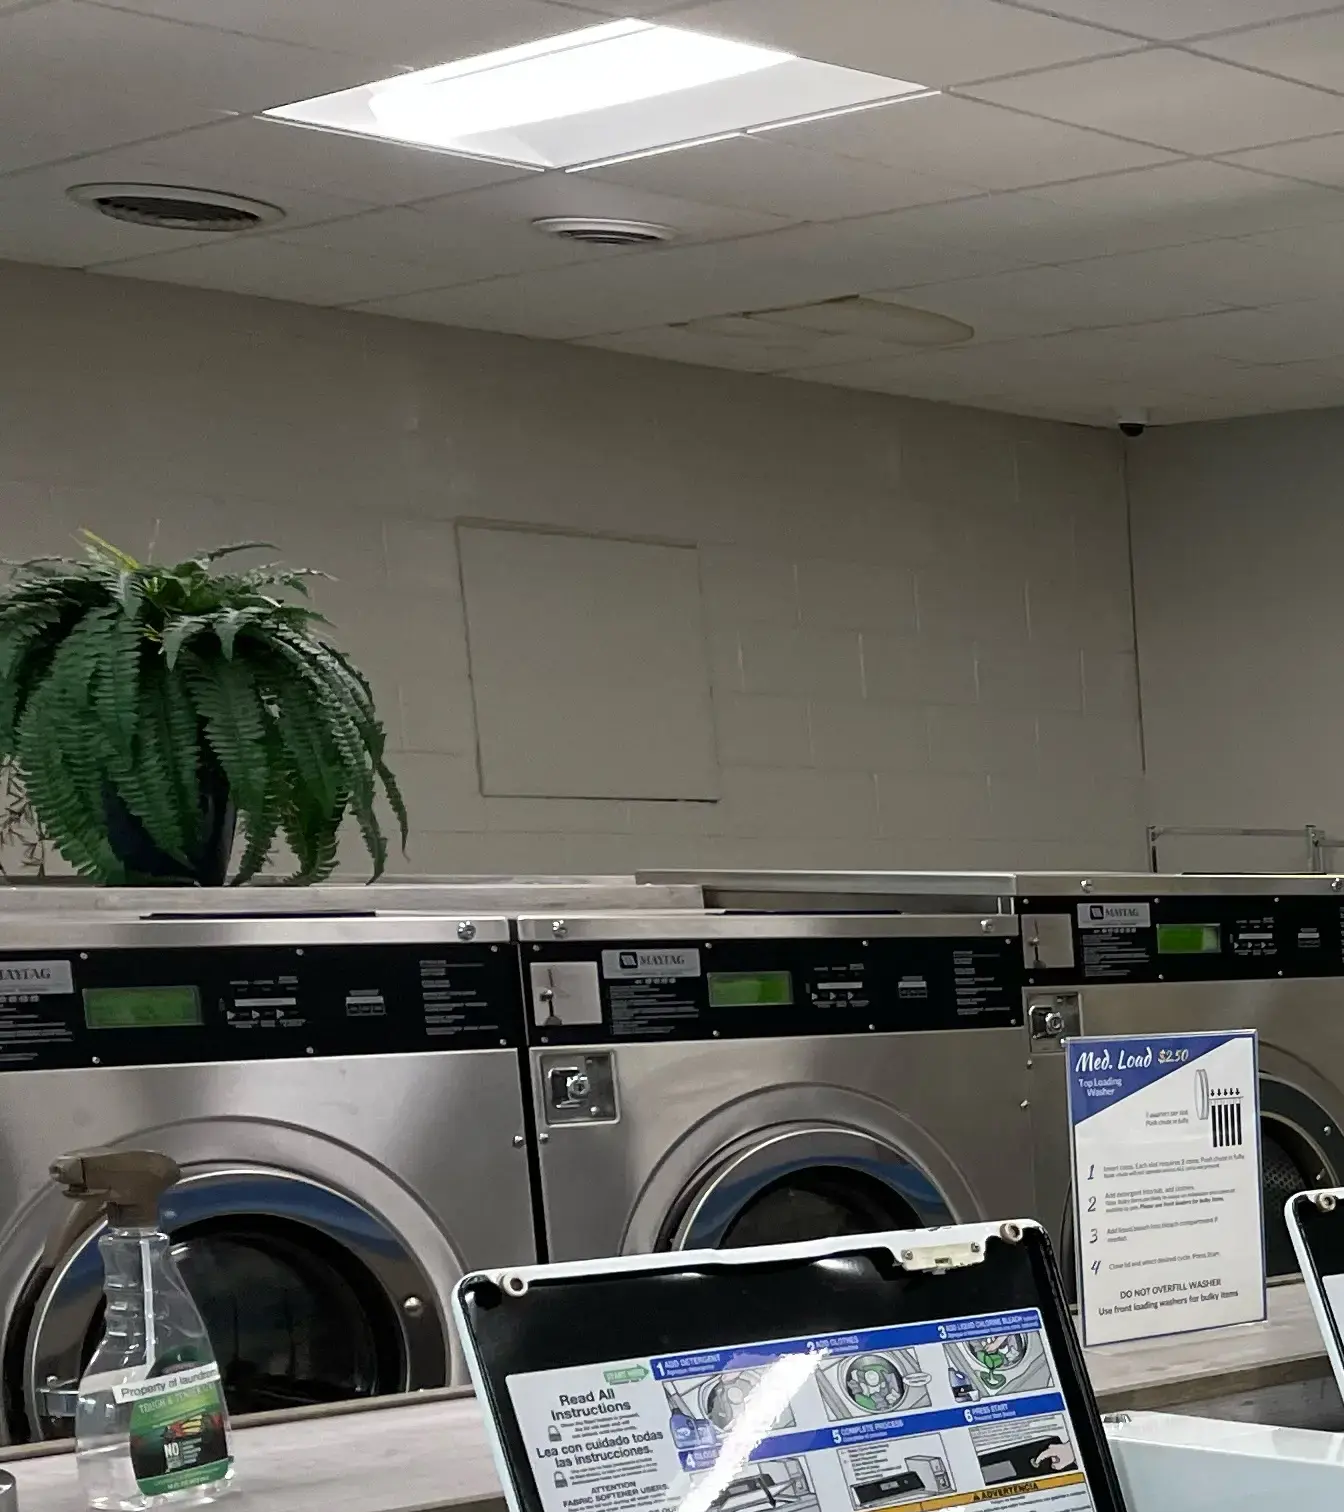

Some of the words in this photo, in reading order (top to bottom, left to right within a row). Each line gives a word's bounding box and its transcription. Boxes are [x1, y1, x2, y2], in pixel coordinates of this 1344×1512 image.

[640, 955, 685, 965] MAYTAG
[1076, 1050, 1112, 1072] Med.
[1118, 1047, 1152, 1069] Load
[1158, 1049, 1189, 1064] $2.50
[1078, 1078, 1093, 1088] Top
[1094, 1076, 1122, 1087] Loading
[1087, 1088, 1115, 1097] Washer
[1087, 1164, 1095, 1180] 1
[1087, 1196, 1097, 1212] 2
[1089, 1228, 1098, 1243] 3
[1090, 1260, 1102, 1275] 4
[1120, 1290, 1133, 1299] DO
[1134, 1287, 1150, 1298] NOT
[1152, 1283, 1187, 1294] OVERFILL
[1189, 1278, 1221, 1289] WASHER
[1098, 1307, 1112, 1316] Use
[1114, 1304, 1132, 1314] front
[1133, 1301, 1158, 1311] loading
[1160, 1297, 1187, 1306] washers
[1189, 1295, 1199, 1303] for
[1201, 1292, 1219, 1303] bulky
[1220, 1290, 1238, 1298] items
[937, 1325, 947, 1339] 3
[656, 1362, 665, 1377] 1
[664, 1360, 679, 1368] ADD
[680, 1353, 721, 1367] DETERGENT
[120, 1382, 166, 1398] Property
[168, 1378, 177, 1387] of
[559, 1391, 595, 1406] Read
[599, 1388, 615, 1401] All
[551, 1401, 631, 1421] Instructions
[964, 1408, 973, 1423] 6
[832, 1429, 842, 1443] 5
[164, 1442, 179, 1457] NO
[536, 1446, 558, 1459] Lea
[561, 1443, 583, 1454] con
[585, 1435, 630, 1451] cuidado
[632, 1431, 664, 1444] todas
[555, 1456, 573, 1468] las
[574, 1445, 653, 1466] instrucciones.
[685, 1453, 695, 1470] 4
[591, 1481, 637, 1494] ATTENTION
[563, 1497, 594, 1507] FABRIC
[596, 1488, 639, 1502] SOFTENER
